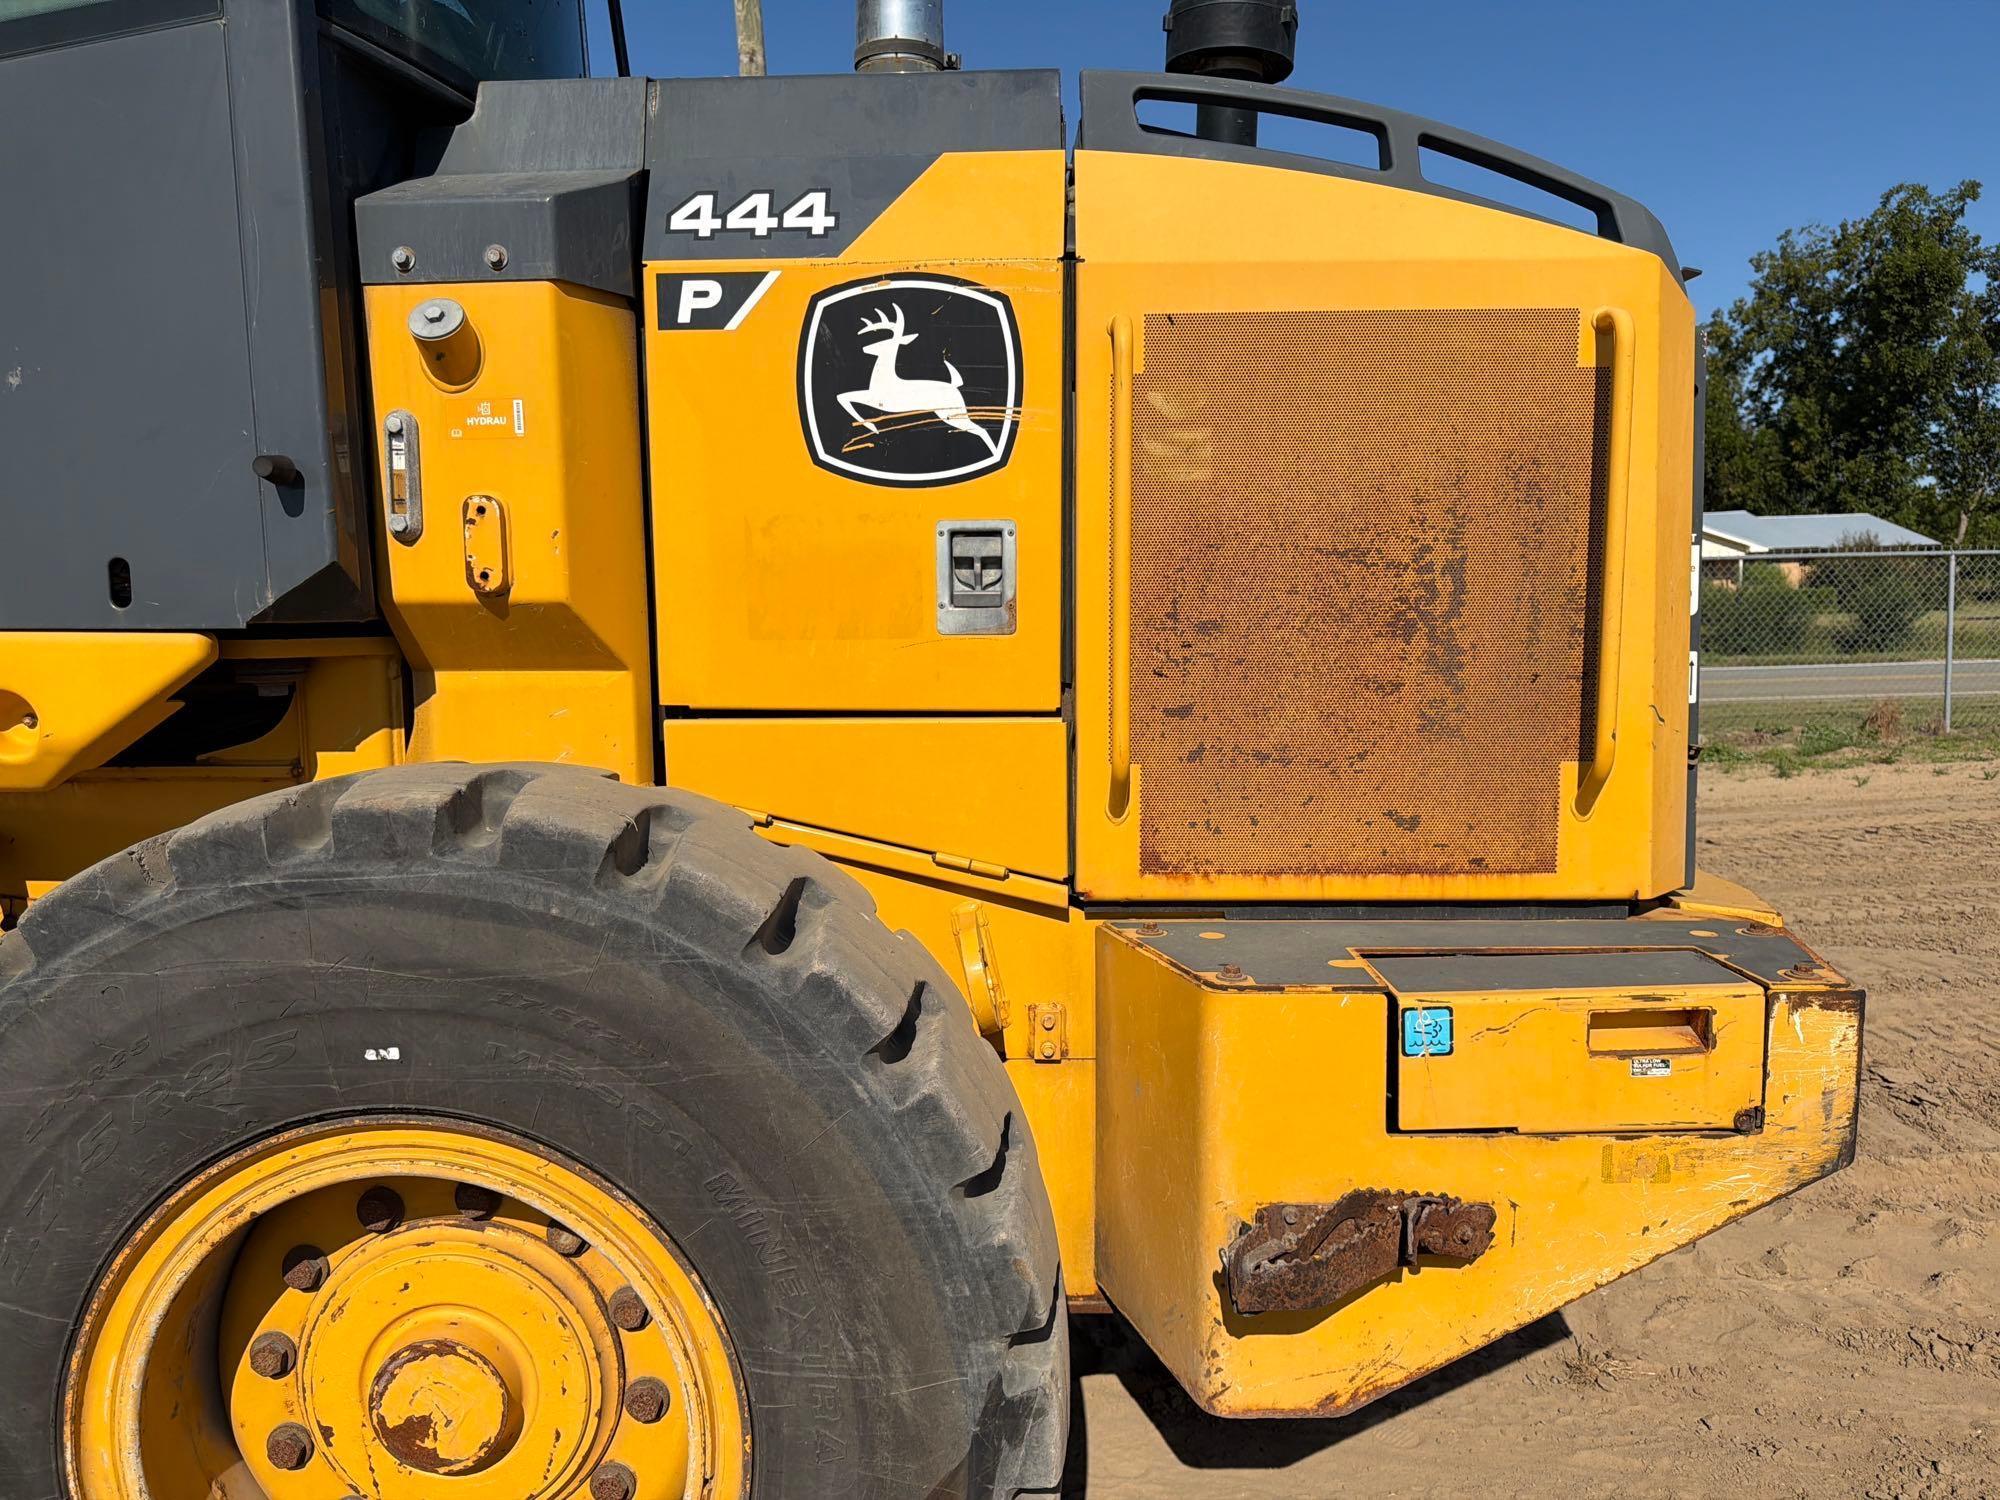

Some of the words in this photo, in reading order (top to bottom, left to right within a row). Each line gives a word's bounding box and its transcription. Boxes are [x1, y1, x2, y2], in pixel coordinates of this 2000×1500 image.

[668, 190, 837, 238] 444
[677, 280, 723, 323] P
[466, 416, 507, 426] HYDRAU
